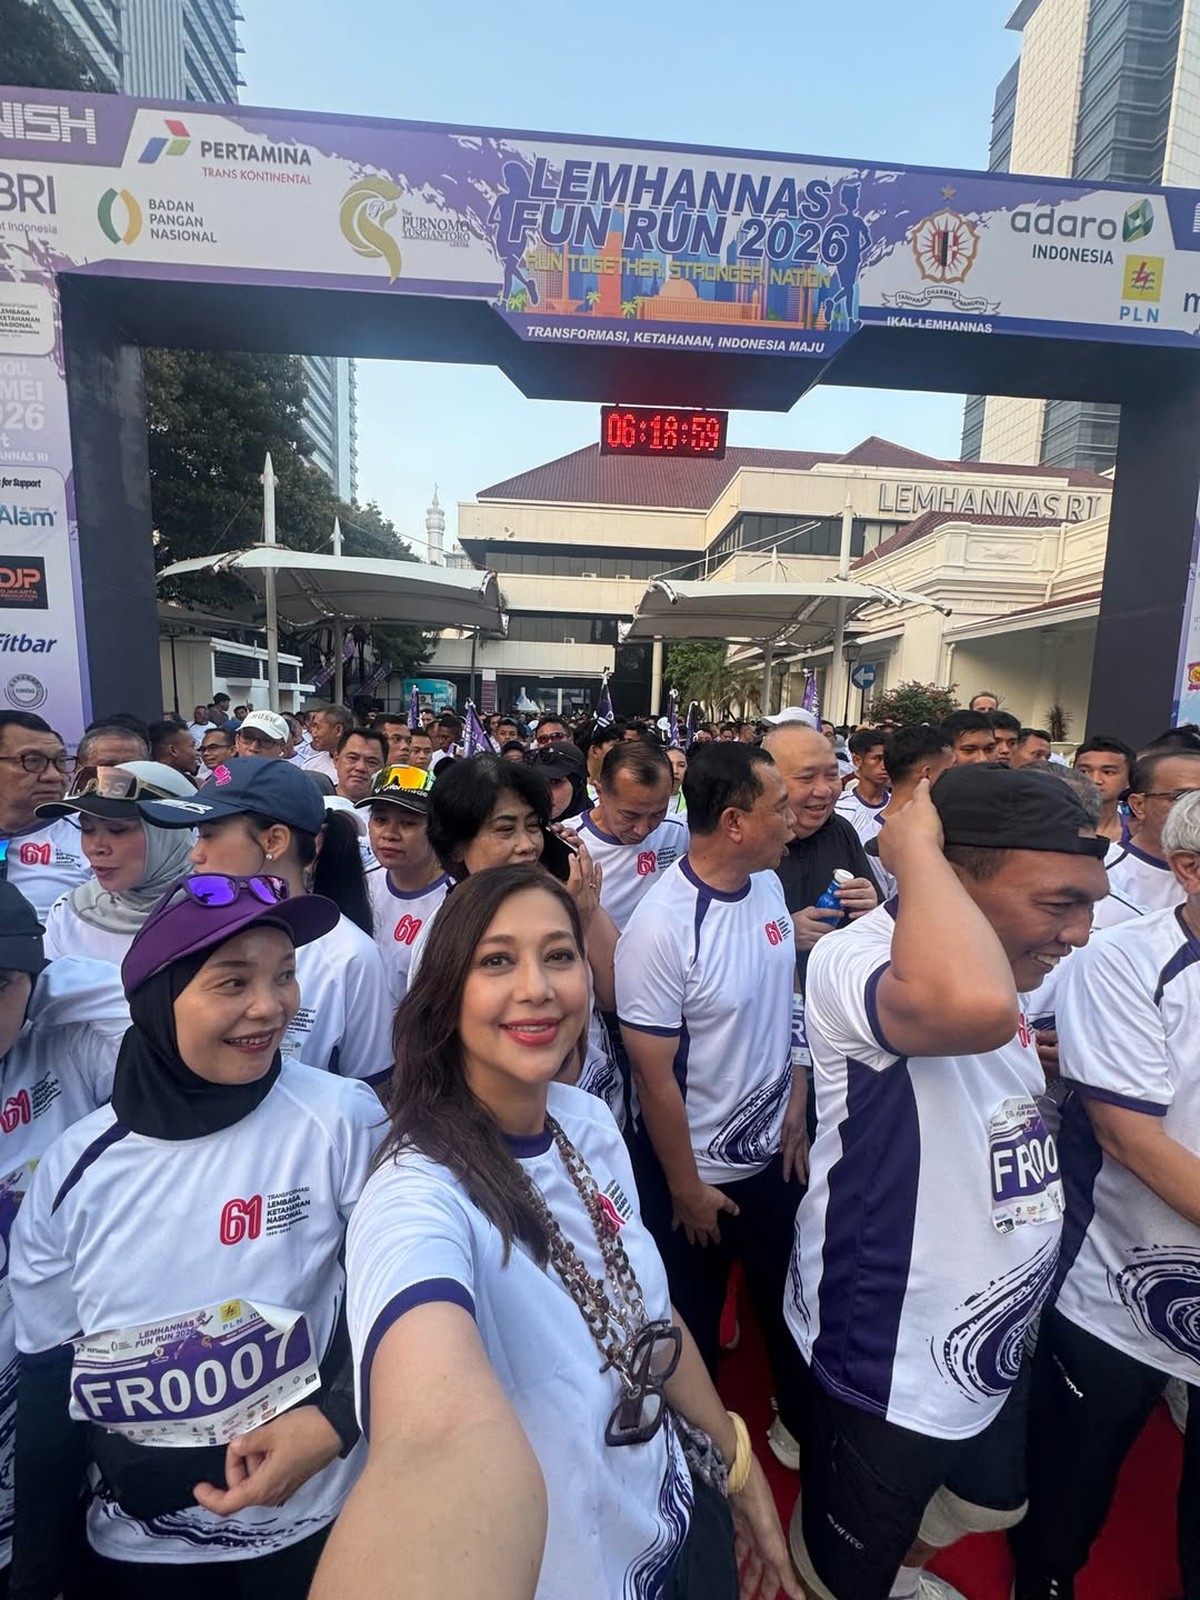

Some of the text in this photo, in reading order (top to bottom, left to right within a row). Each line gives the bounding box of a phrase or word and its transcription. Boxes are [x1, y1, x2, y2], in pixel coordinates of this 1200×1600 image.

[200, 140, 312, 166] PERTAMINA
[202, 166, 312, 185] TRANS KONTINENTAL
[528, 157, 832, 221] LEMHANNAS
[149, 198, 194, 213] BADAN
[8, 221, 58, 235] Indonesia
[149, 213, 204, 228] PANGAN
[402, 216, 470, 232] PURNOMO
[1010, 208, 1118, 241] adaro
[150, 227, 217, 244] NASIONAL
[402, 229, 470, 241] YUSGIANTORO
[507, 200, 849, 265] FUN RUN 2026
[1032, 243, 1114, 265] INDONESIA
[525, 252, 563, 271] RUN
[770, 267, 833, 289] NATION
[1119, 305, 1160, 323] PLN
[886, 315, 993, 334] IKAL-LEMHANNAS
[526, 326, 826, 354] TRANSFORMASI, KETAHANAN, INDONESIA MAJU
[0, 401, 45, 431] 26
[607, 413, 720, 451] 06:18:59
[1, 477, 42, 489] for Support
[879, 483, 1061, 519] LEMHANNAS
[0, 505, 54, 527] Alam
[20, 842, 51, 866] 61
[638, 851, 657, 876] 61
[393, 914, 423, 946] 61
[0, 1088, 32, 1134] 61
[267, 1194, 301, 1209] LEMBAGA
[268, 1186, 310, 1201] TRANSFORMASI
[266, 1199, 311, 1217] KETAHANAN
[266, 1210, 303, 1225] NASIONAL
[219, 1193, 263, 1246] 61
[139, 1320, 195, 1339] LEMHANNAS
[222, 1317, 243, 1331] PLN
[135, 1338, 154, 1348] FUN
[155, 1332, 174, 1344] RUN
[80, 1323, 296, 1417] FR0007
